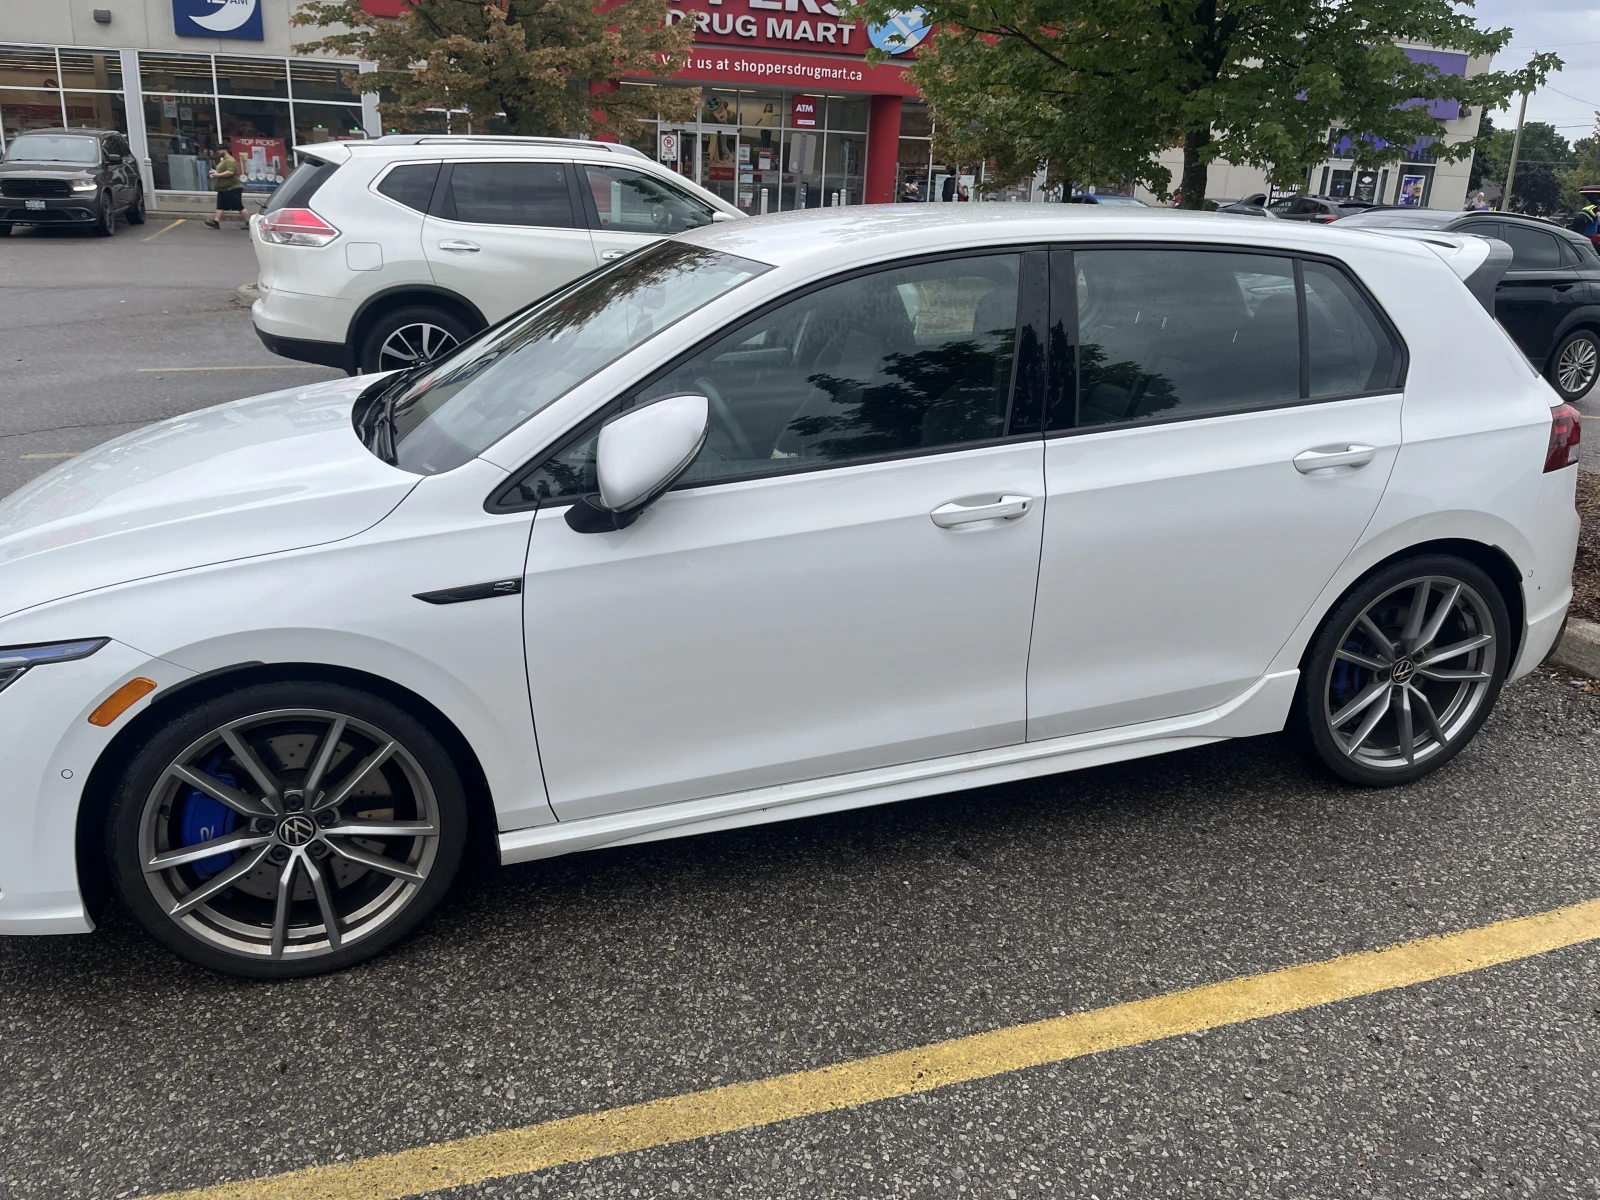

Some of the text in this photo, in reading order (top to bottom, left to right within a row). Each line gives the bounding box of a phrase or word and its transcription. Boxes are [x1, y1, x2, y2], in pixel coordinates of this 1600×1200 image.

[766, 17, 856, 45] MART
[661, 53, 862, 81] Vit us at shoppersdrugmart.ca
[795, 103, 814, 113] ATM
[240, 138, 275, 147] TOP PICKS
